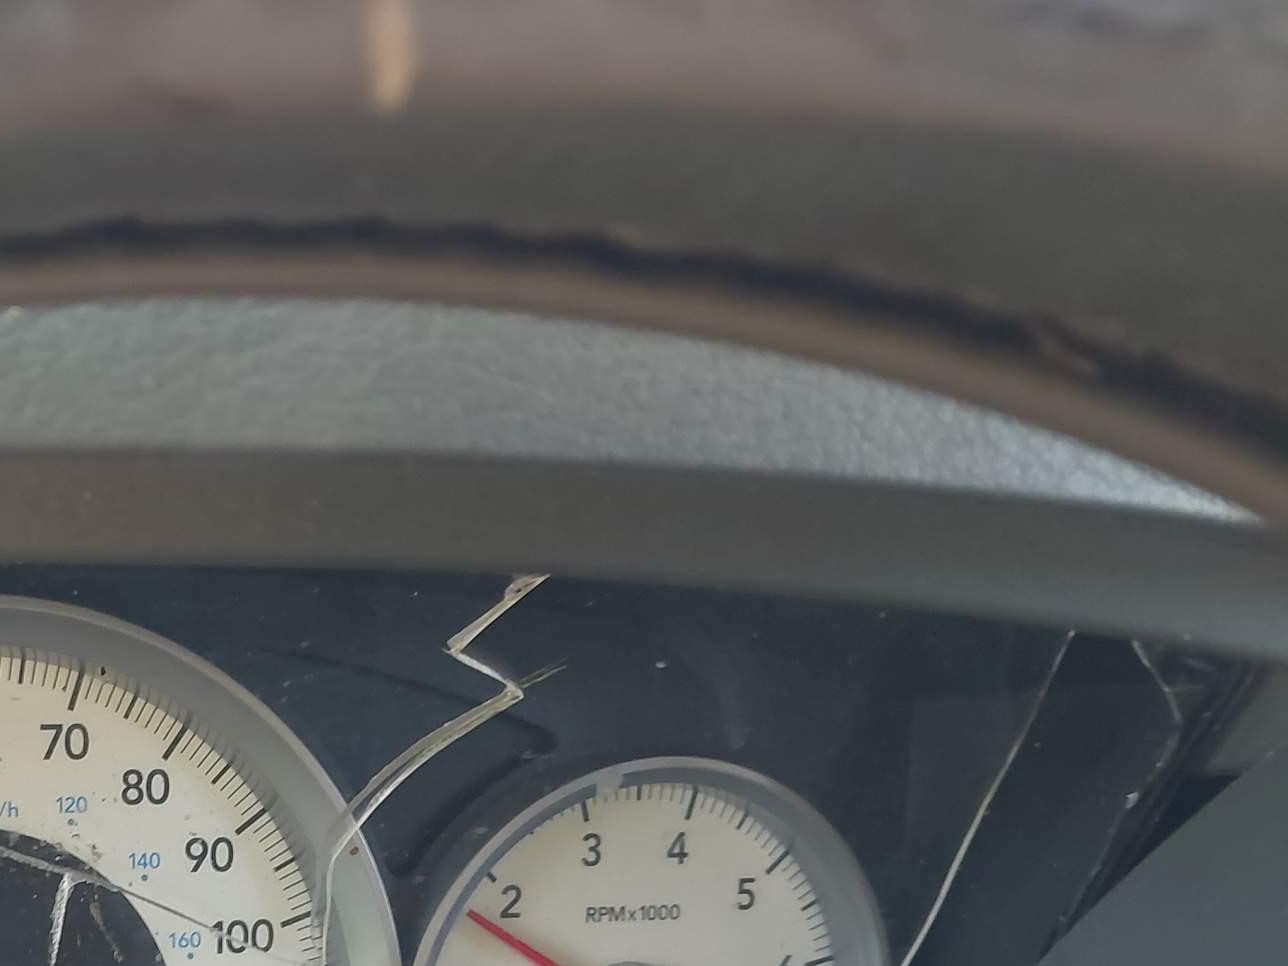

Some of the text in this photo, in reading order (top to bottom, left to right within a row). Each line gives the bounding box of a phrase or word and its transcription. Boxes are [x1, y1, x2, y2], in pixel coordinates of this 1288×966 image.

[39, 723, 90, 761] 70
[120, 769, 171, 806] 80
[55, 796, 88, 815] 120
[127, 852, 162, 871] 140
[184, 836, 235, 874] 90
[580, 833, 603, 867] 3
[666, 832, 690, 865] 4
[499, 884, 523, 919] 2
[735, 877, 758, 911] 5
[168, 932, 202, 951] 160
[211, 918, 275, 954] 100
